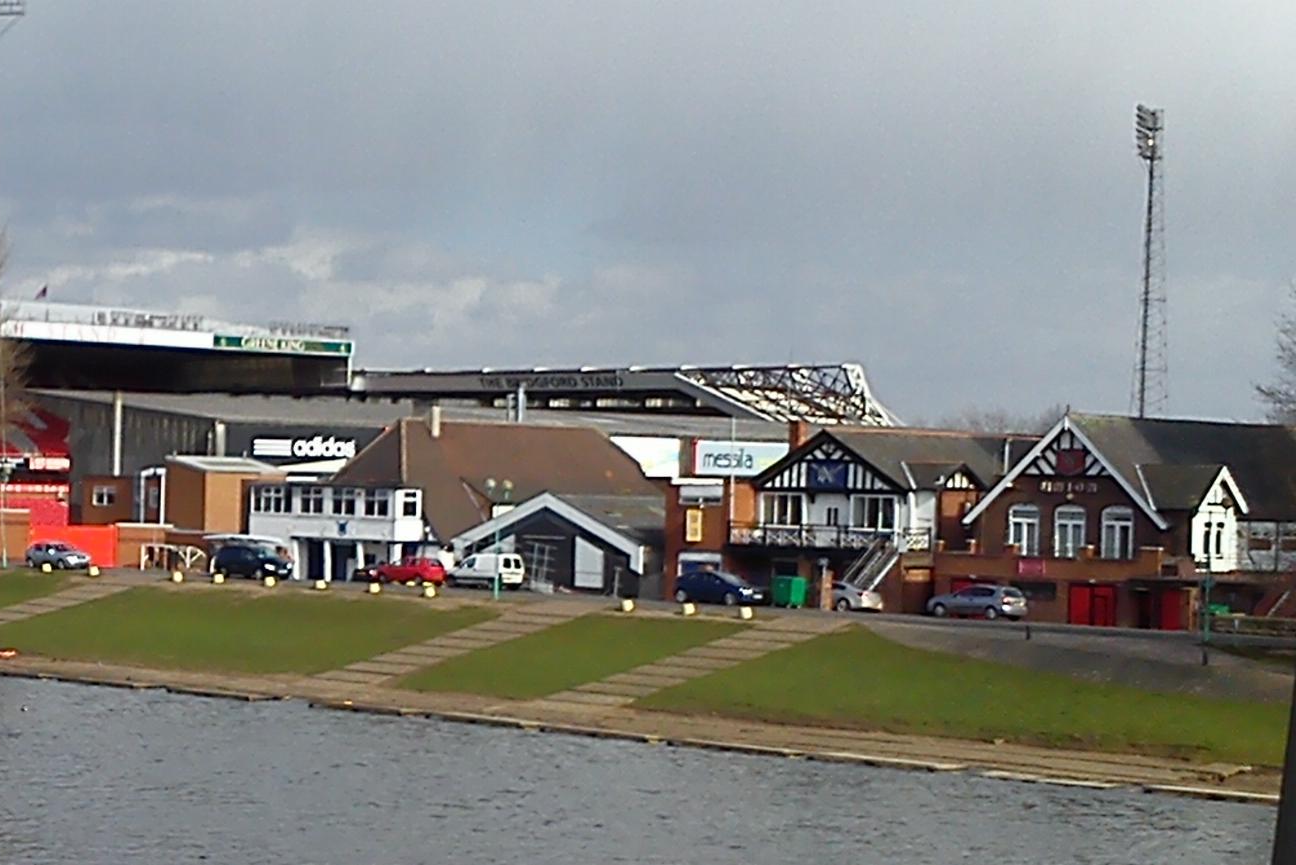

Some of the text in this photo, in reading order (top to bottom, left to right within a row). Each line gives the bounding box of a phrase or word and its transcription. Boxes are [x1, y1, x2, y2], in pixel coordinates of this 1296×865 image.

[480, 377, 504, 388] THE
[581, 375, 623, 388] STAND
[293, 436, 356, 458] adidas
